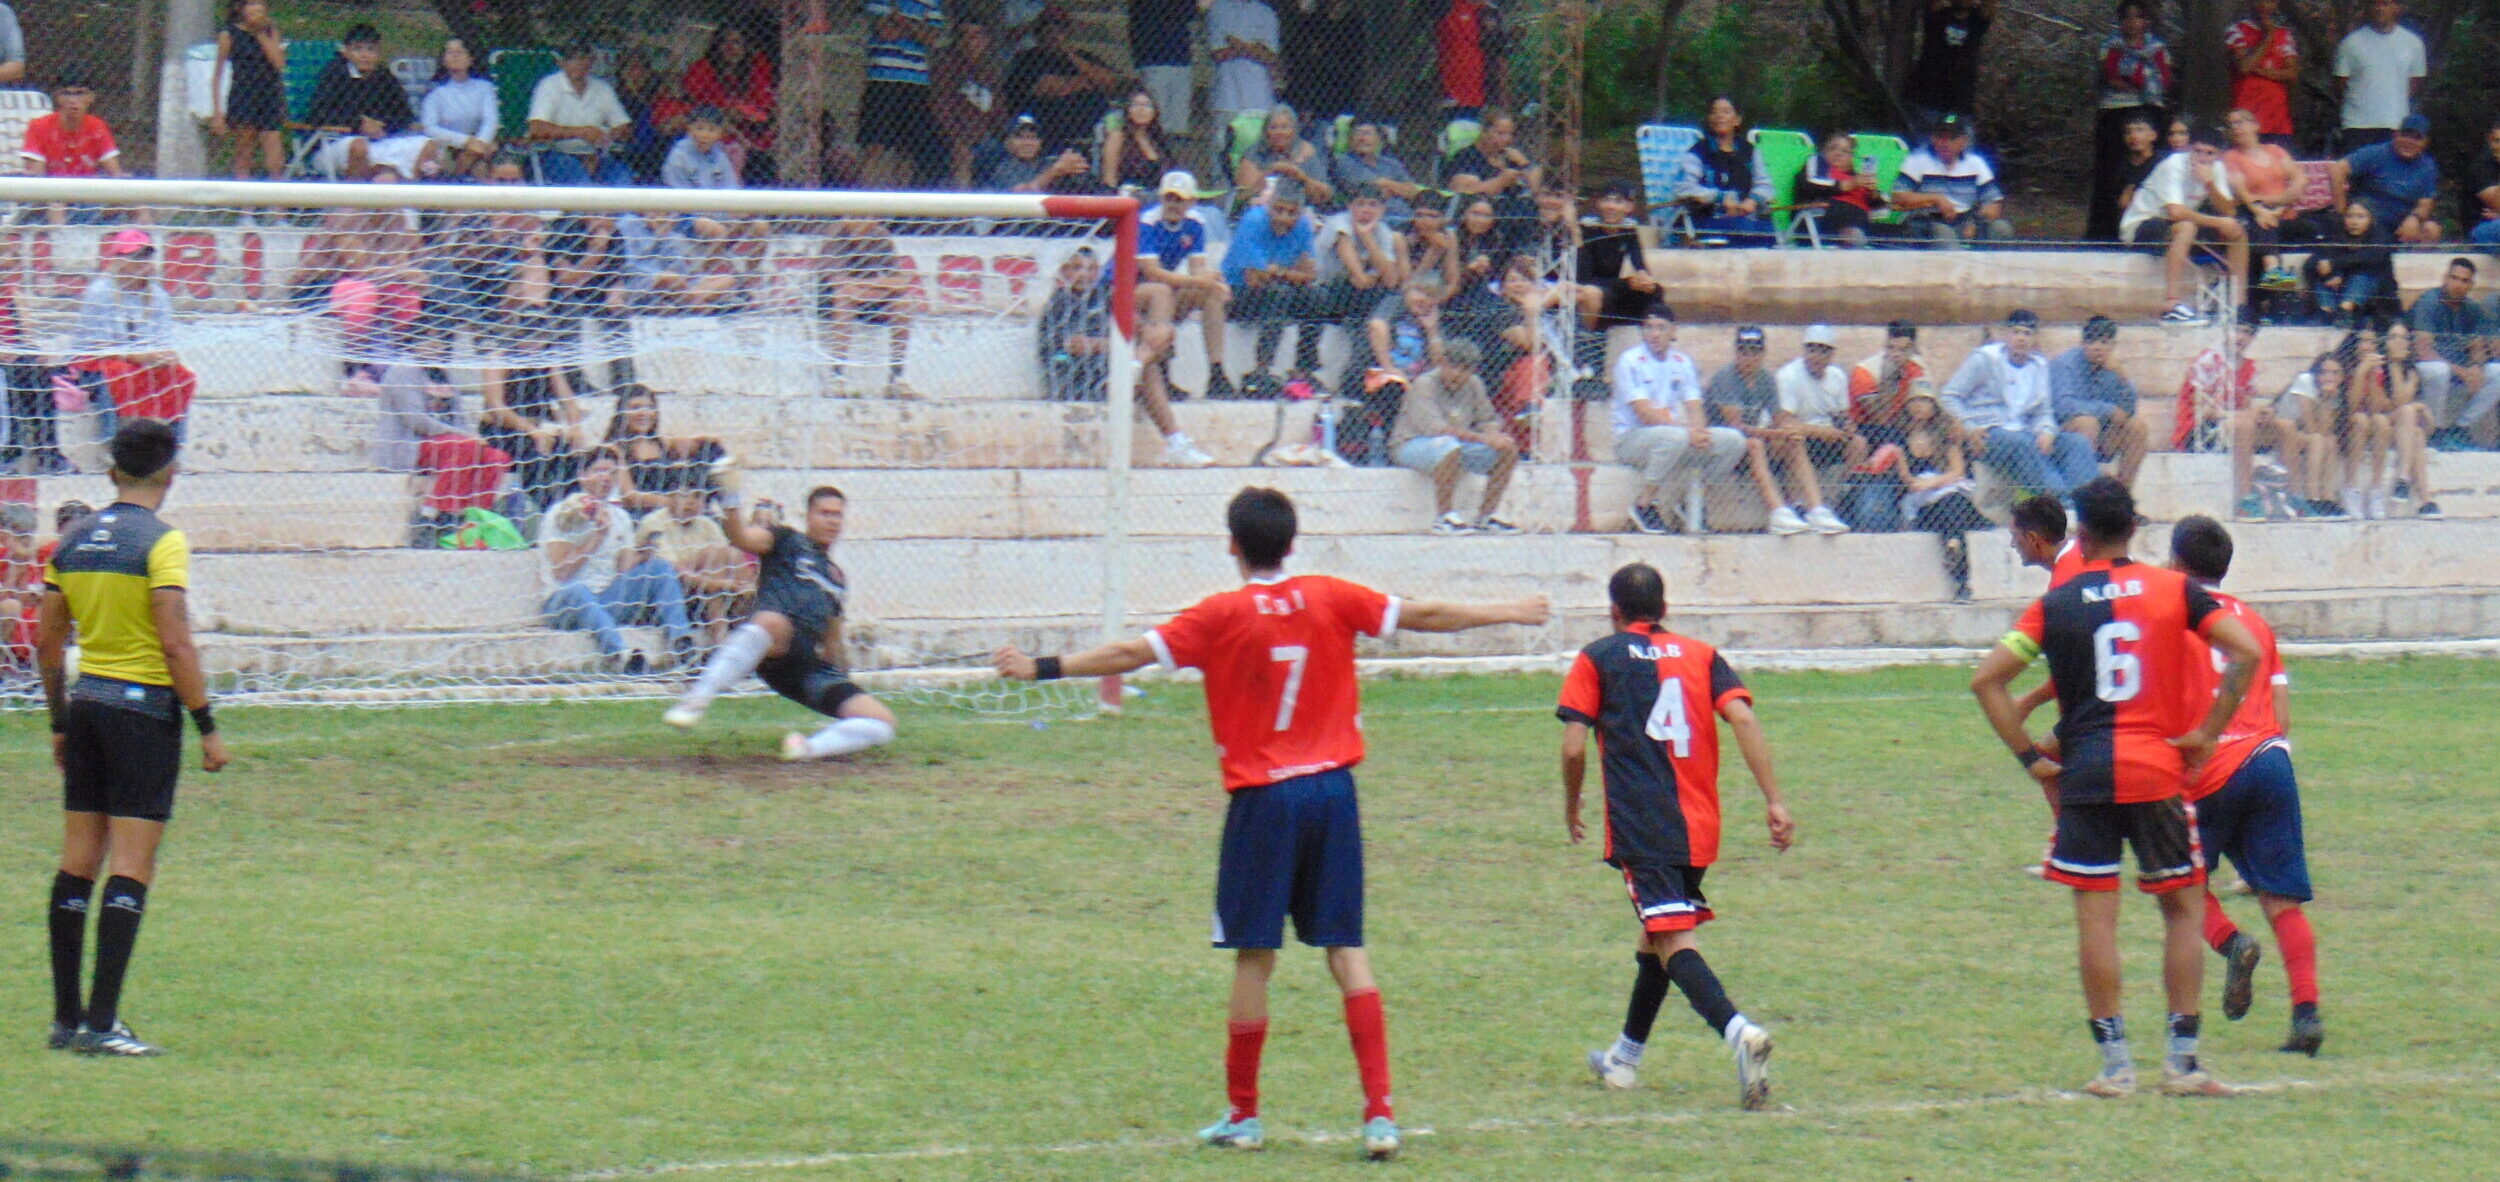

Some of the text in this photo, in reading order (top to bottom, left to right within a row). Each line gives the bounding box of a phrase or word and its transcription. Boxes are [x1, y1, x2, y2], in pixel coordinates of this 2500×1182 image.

[1269, 645, 1309, 732] 7
[2092, 619, 2142, 703] 6
[1644, 676, 1692, 758] 4
